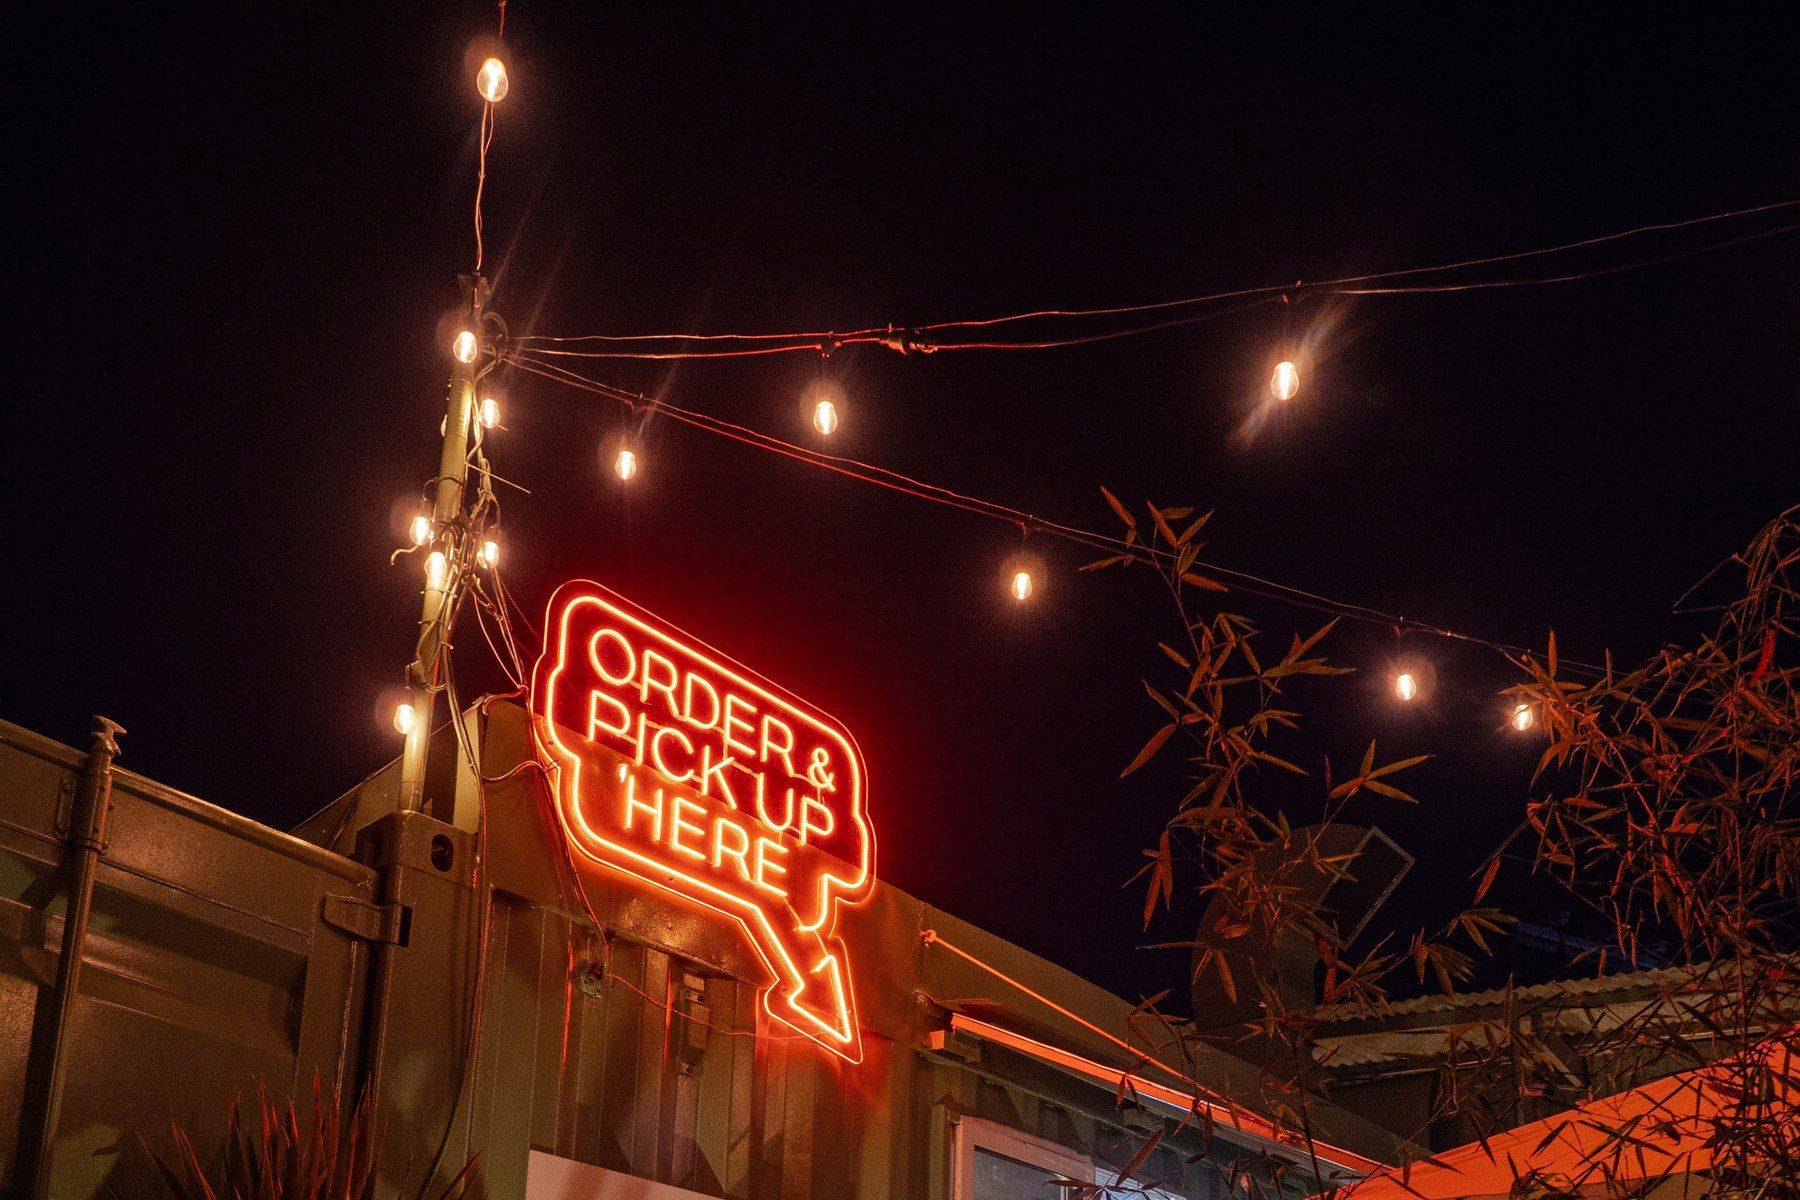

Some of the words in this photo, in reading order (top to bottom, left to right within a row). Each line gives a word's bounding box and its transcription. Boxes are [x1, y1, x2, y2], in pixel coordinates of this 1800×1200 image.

[587, 627, 797, 776] ORDER
[809, 746, 836, 792] &
[587, 688, 737, 810] PICK
[756, 770, 835, 847] UP
[621, 774, 789, 897] HERE
